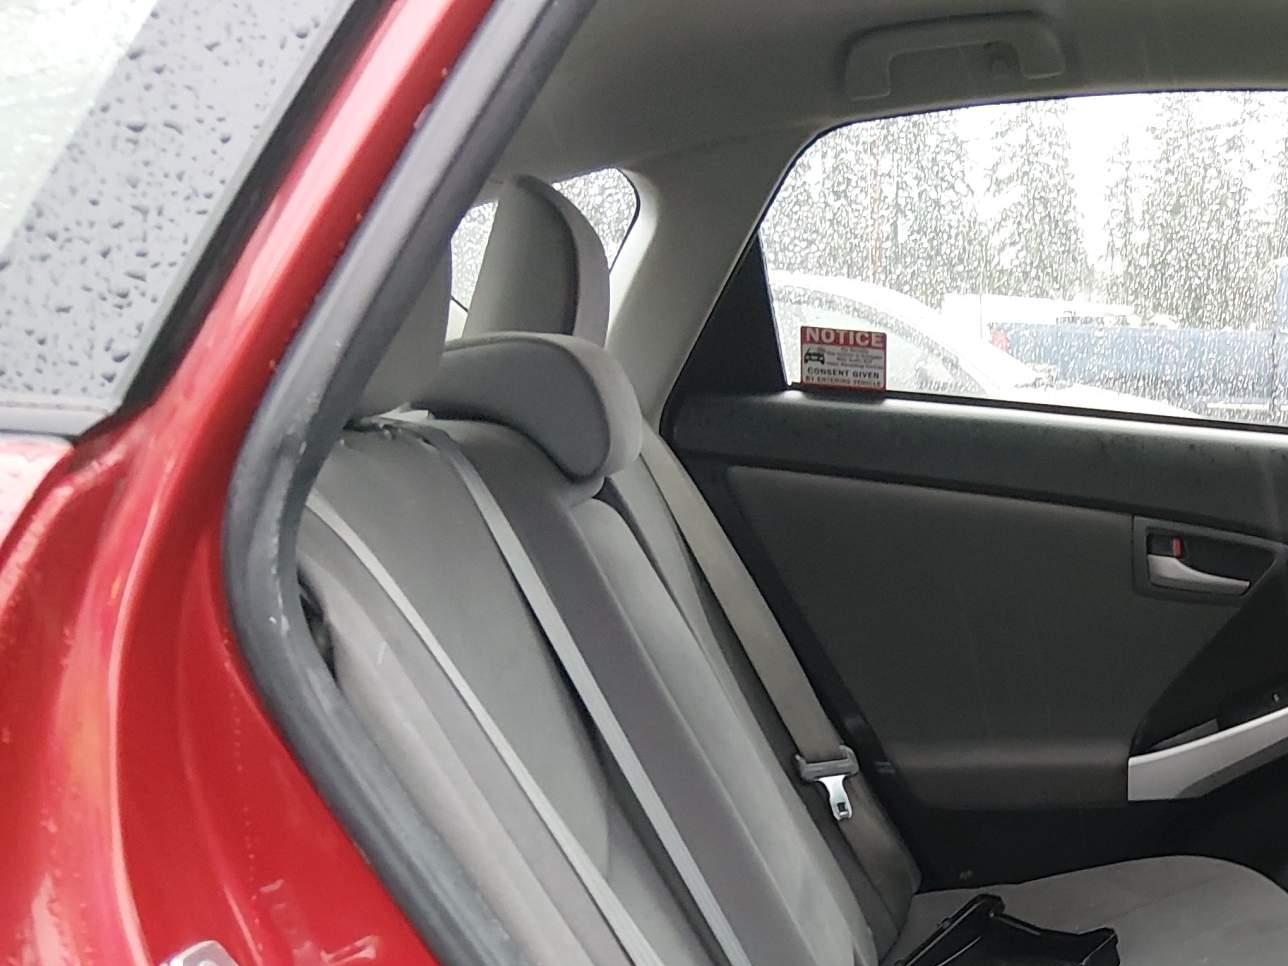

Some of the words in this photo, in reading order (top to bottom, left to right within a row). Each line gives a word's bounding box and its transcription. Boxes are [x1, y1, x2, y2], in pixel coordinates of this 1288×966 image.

[806, 327, 883, 347] NOTICE
[807, 367, 849, 376] CONSENT
[852, 369, 880, 379] GIVEN
